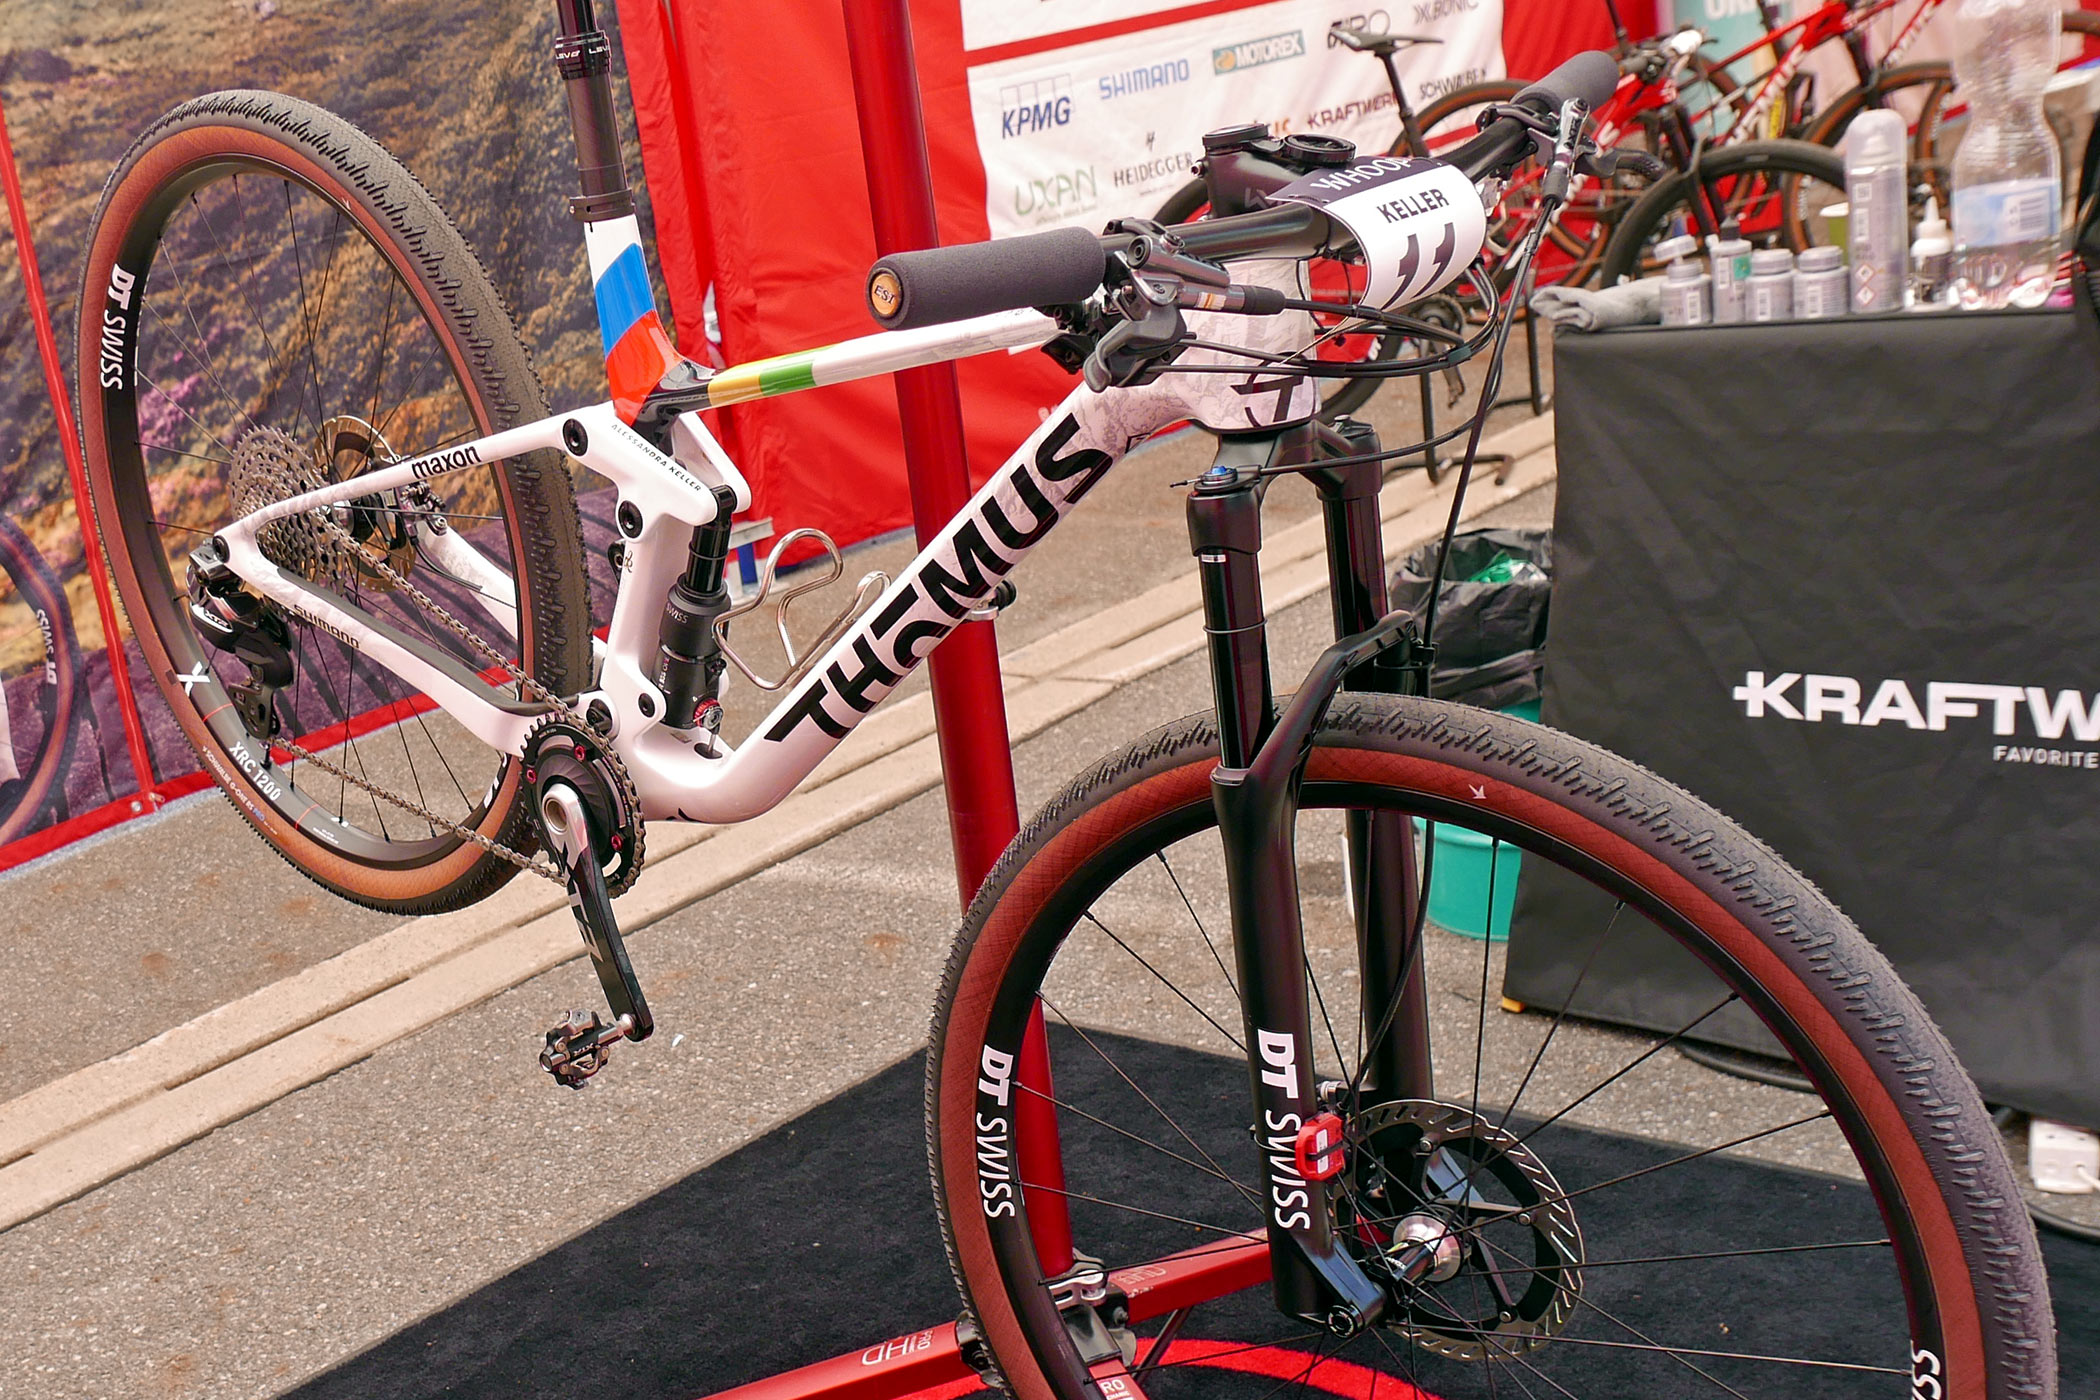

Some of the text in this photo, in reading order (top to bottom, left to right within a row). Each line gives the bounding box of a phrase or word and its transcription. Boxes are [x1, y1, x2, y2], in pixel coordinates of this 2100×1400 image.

[1236, 33, 1303, 67] MOTOREX
[1099, 59, 1190, 100] SHIMANO
[1001, 96, 1071, 139] KPMG
[1113, 152, 1193, 188] HEIDEGGER
[1376, 188, 1450, 223] KELLER
[1379, 222, 1456, 311] 11
[874, 285, 895, 305] ESI
[100, 263, 136, 390] DT SWISS
[411, 446, 482, 479] maxon
[611, 424, 702, 492] ALESSANDRA KELLER
[37, 608, 55, 655] SWISS
[293, 604, 360, 649] SHIMANO
[228, 741, 257, 773] XRC
[252, 769, 282, 802] 1200
[1993, 745, 2099, 770] FAVORITE
[976, 1044, 1016, 1218] DT SWISS
[1257, 1028, 1311, 1230] DT SWISS
